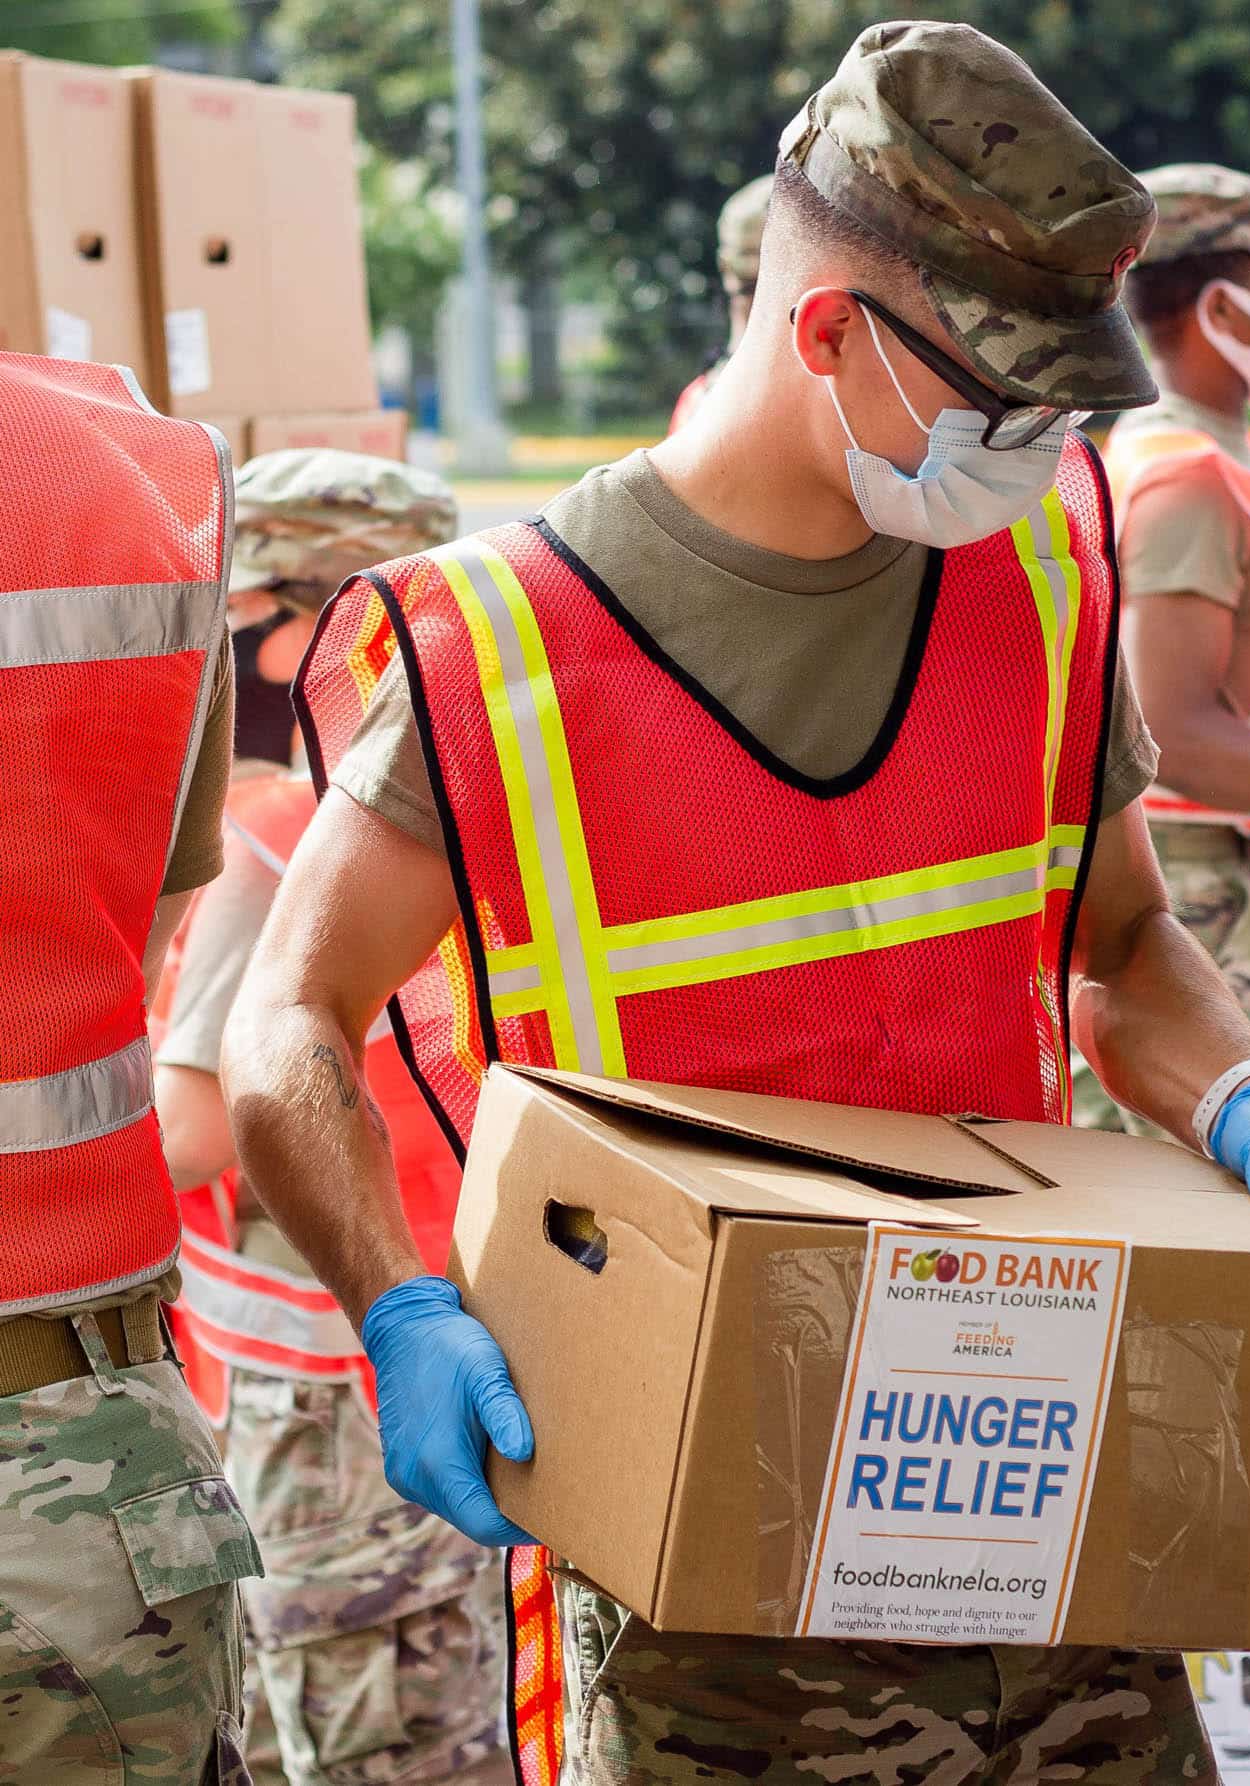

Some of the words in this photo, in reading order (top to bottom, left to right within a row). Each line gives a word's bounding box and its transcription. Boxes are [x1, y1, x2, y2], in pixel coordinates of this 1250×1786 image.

[889, 1246, 987, 1285] FOOD
[995, 1253, 1103, 1292] BANK
[887, 1286, 997, 1306] NORTHEAST
[1000, 1292, 1097, 1312] LOUISIANA
[953, 1344, 1013, 1358] AMERICA
[955, 1332, 1017, 1346] FEEDING
[859, 1390, 1078, 1451] HUNGER
[846, 1454, 1069, 1518] RELIEF
[833, 1562, 1047, 1599] foodbanknela.org
[831, 1601, 884, 1618] Providing
[887, 1603, 912, 1617] food,
[915, 1604, 940, 1619] hope
[942, 1606, 963, 1618] and
[964, 1607, 1002, 1622] dignity
[1005, 1611, 1016, 1620] to
[1018, 1612, 1037, 1621] our
[834, 1618, 887, 1632] neighbors
[890, 1620, 913, 1632] who
[914, 1622, 960, 1637] struggle
[962, 1623, 987, 1635] with
[988, 1623, 1028, 1639] hunger.
